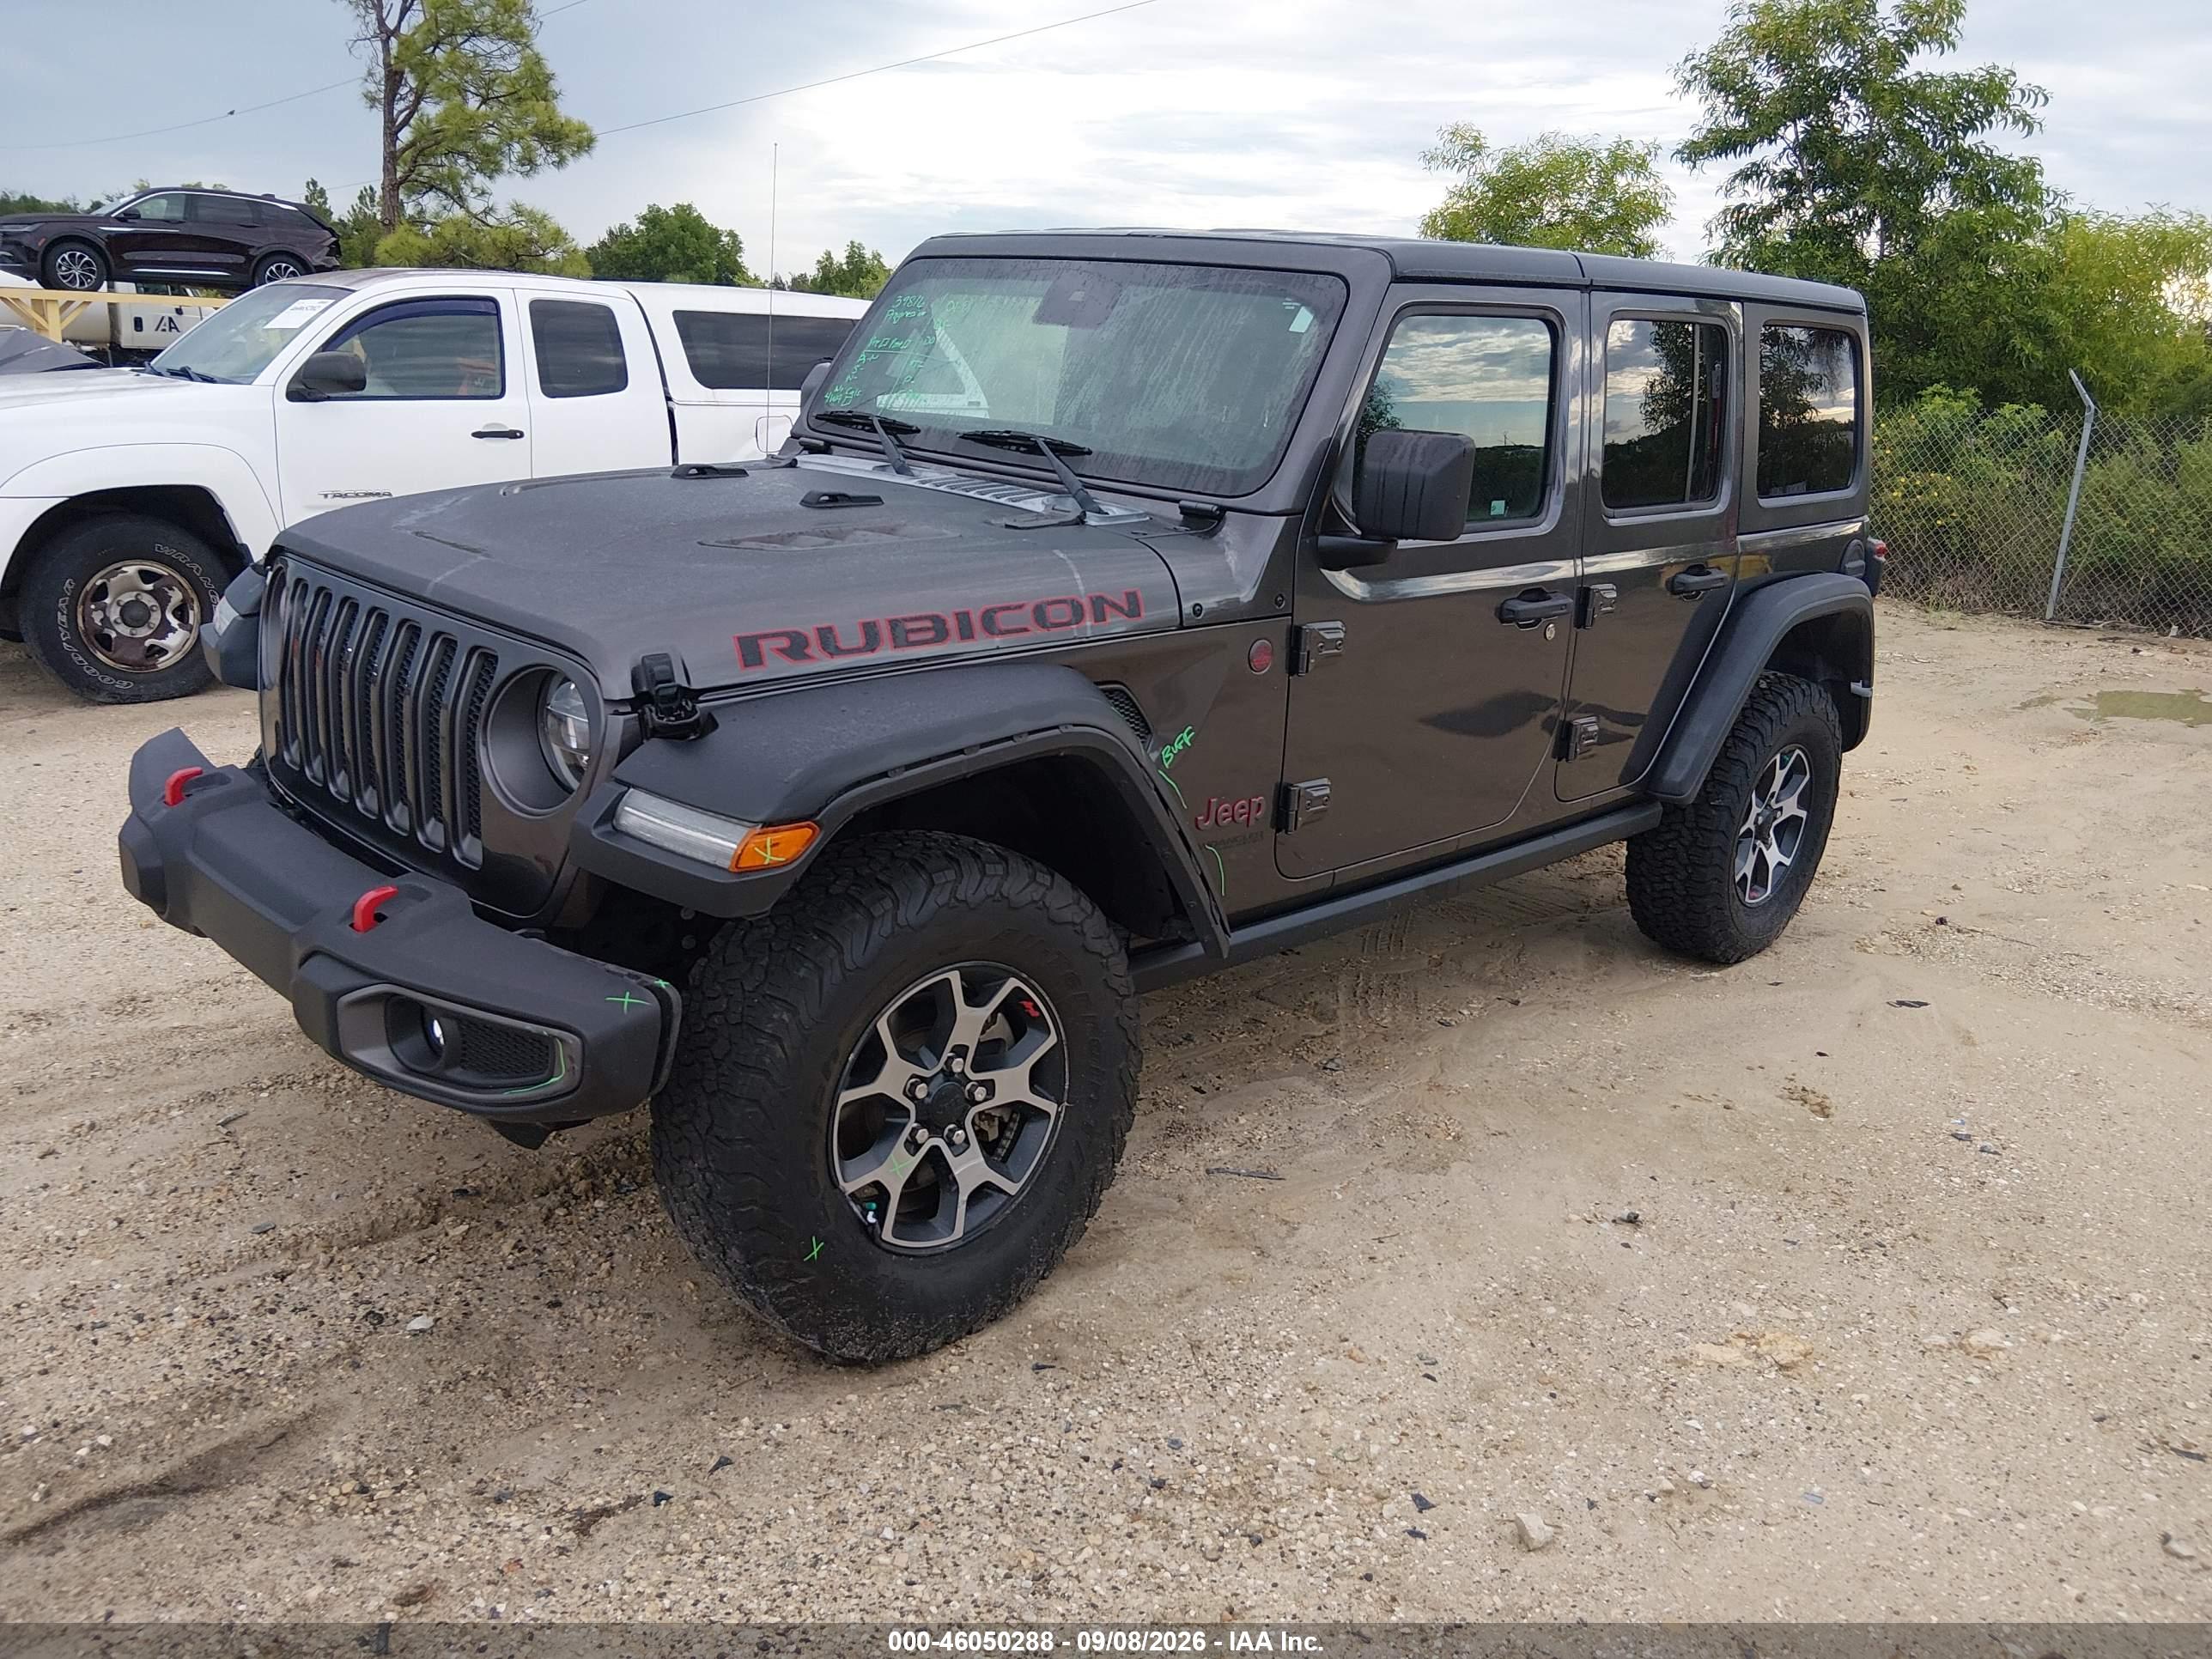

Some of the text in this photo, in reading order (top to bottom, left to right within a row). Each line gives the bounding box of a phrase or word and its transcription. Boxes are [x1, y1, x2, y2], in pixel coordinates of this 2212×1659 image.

[317, 489, 393, 499] TACOMA
[155, 544, 220, 612] WRANG
[57, 578, 134, 689] GOODYEAR
[733, 589, 1145, 672] RUBICON
[1195, 796, 1264, 830] Jeep
